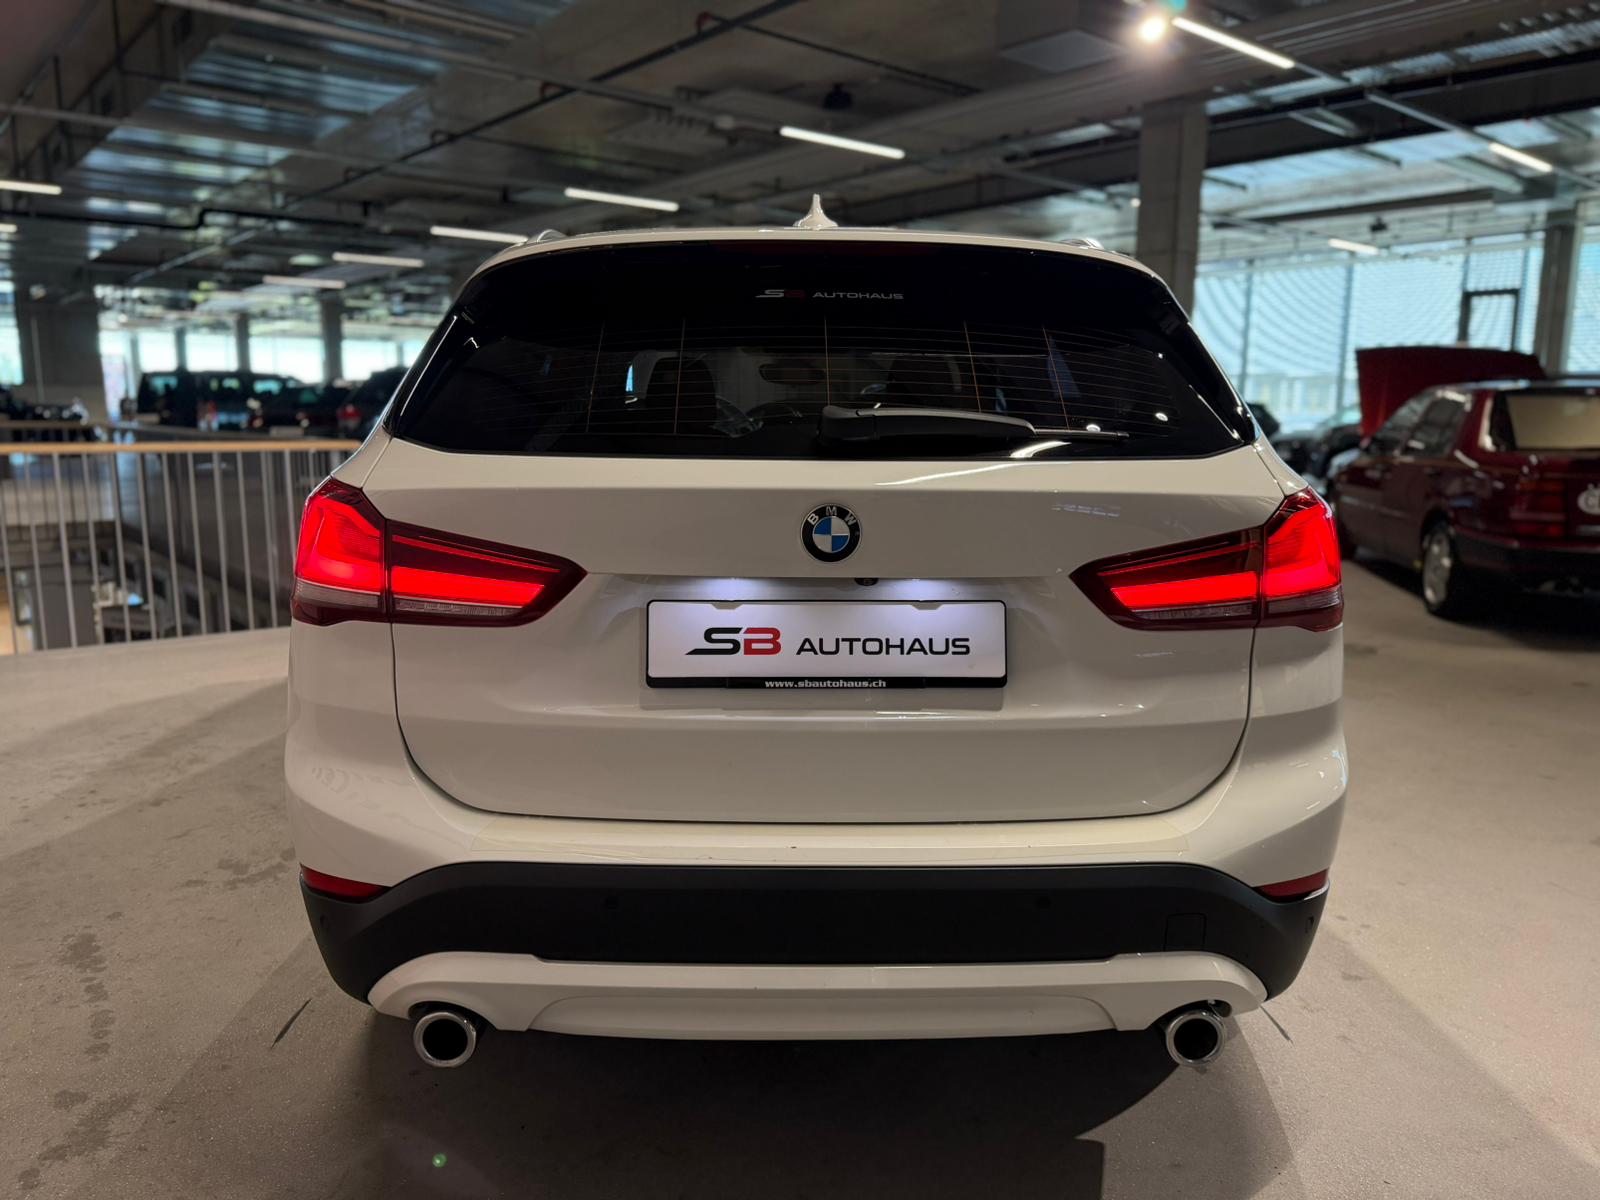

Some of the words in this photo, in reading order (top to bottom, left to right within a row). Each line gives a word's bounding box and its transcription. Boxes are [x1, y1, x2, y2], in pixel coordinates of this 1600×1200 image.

[812, 291, 904, 300] AUTOHAUS
[806, 506, 857, 526] BMW
[685, 627, 781, 655] SB
[796, 638, 970, 656] AUTOHAUS
[765, 679, 886, 689] www.sbautohaus.ch
